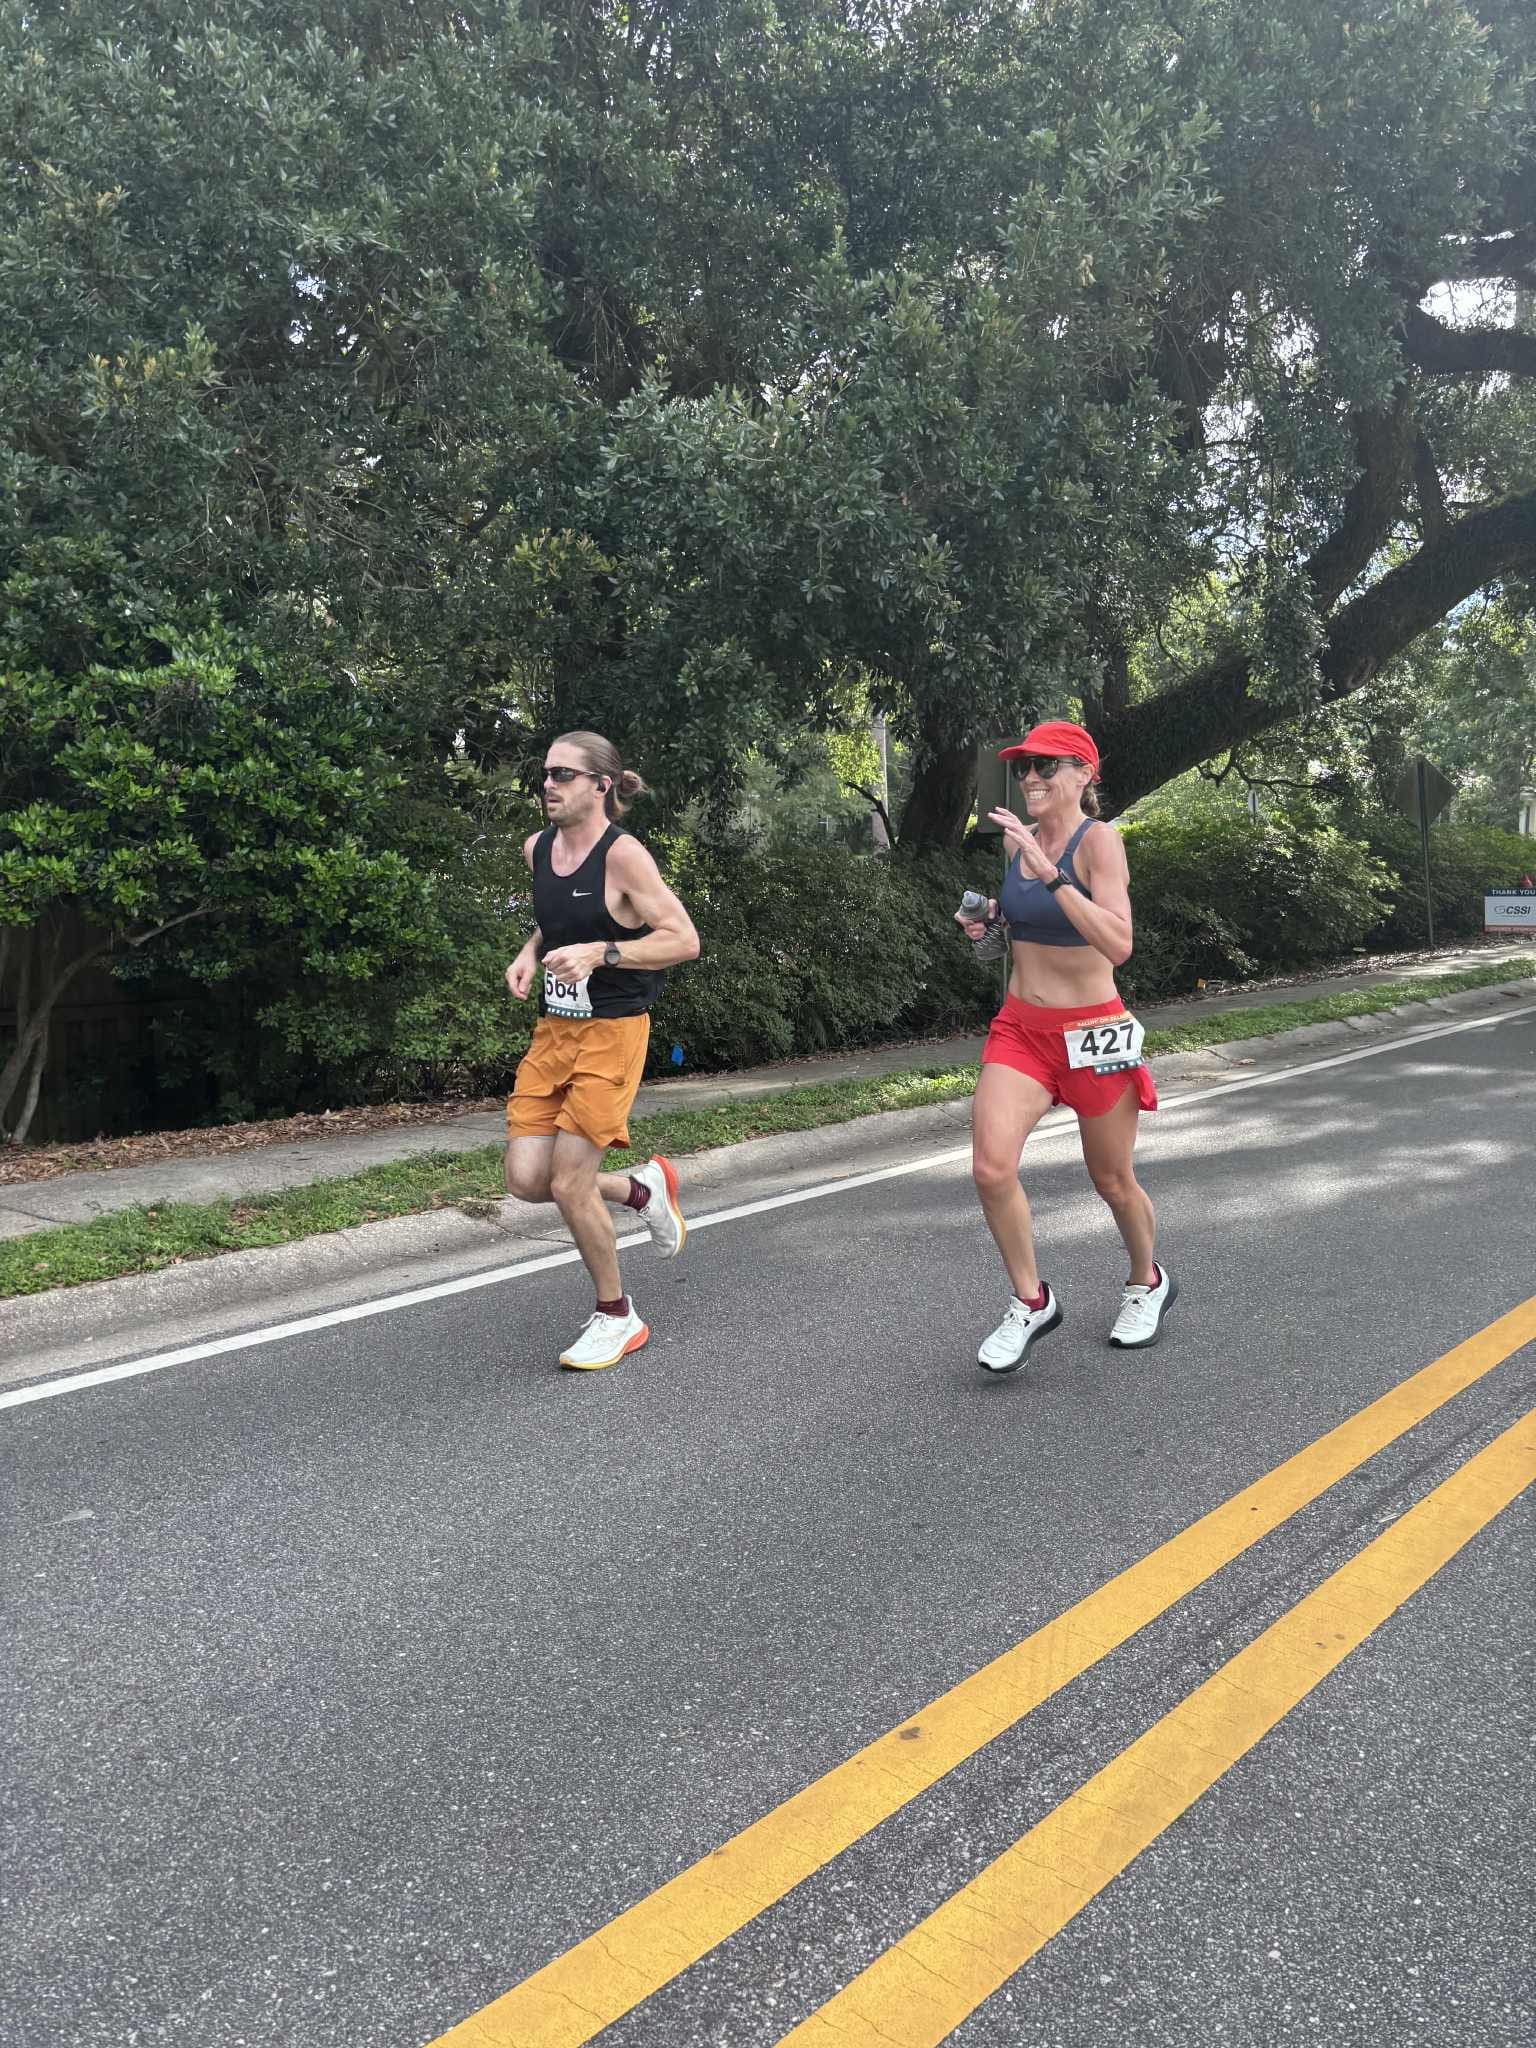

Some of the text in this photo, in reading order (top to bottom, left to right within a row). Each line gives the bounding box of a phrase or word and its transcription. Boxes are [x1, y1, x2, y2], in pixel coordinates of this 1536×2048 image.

[1506, 905, 1531, 915] CSSI
[547, 972, 578, 1001] 564
[1080, 1023, 1134, 1056] 427
